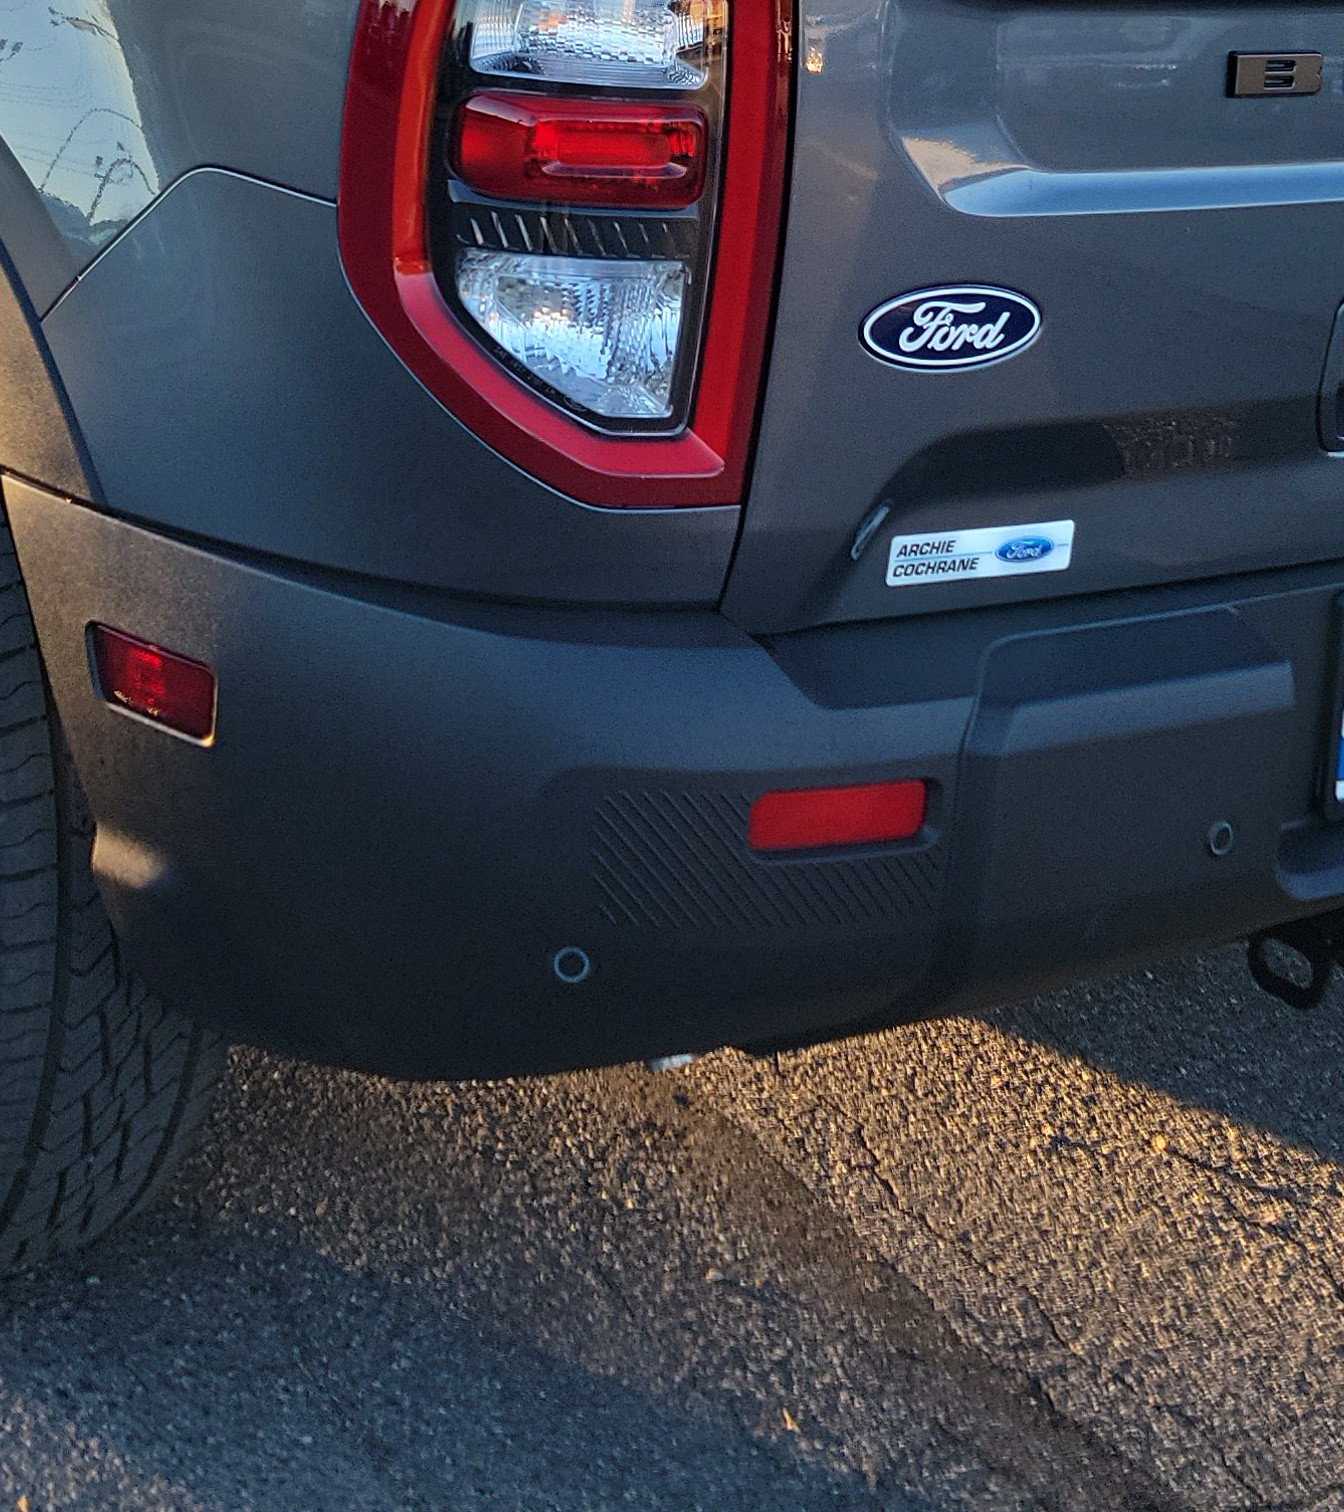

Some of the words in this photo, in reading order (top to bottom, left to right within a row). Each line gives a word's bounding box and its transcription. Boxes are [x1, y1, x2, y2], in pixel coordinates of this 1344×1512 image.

[898, 300, 1011, 353] Ford
[896, 539, 957, 559] ARCHIE
[1006, 541, 1044, 559] Ford
[892, 557, 980, 578] COCHRANE
